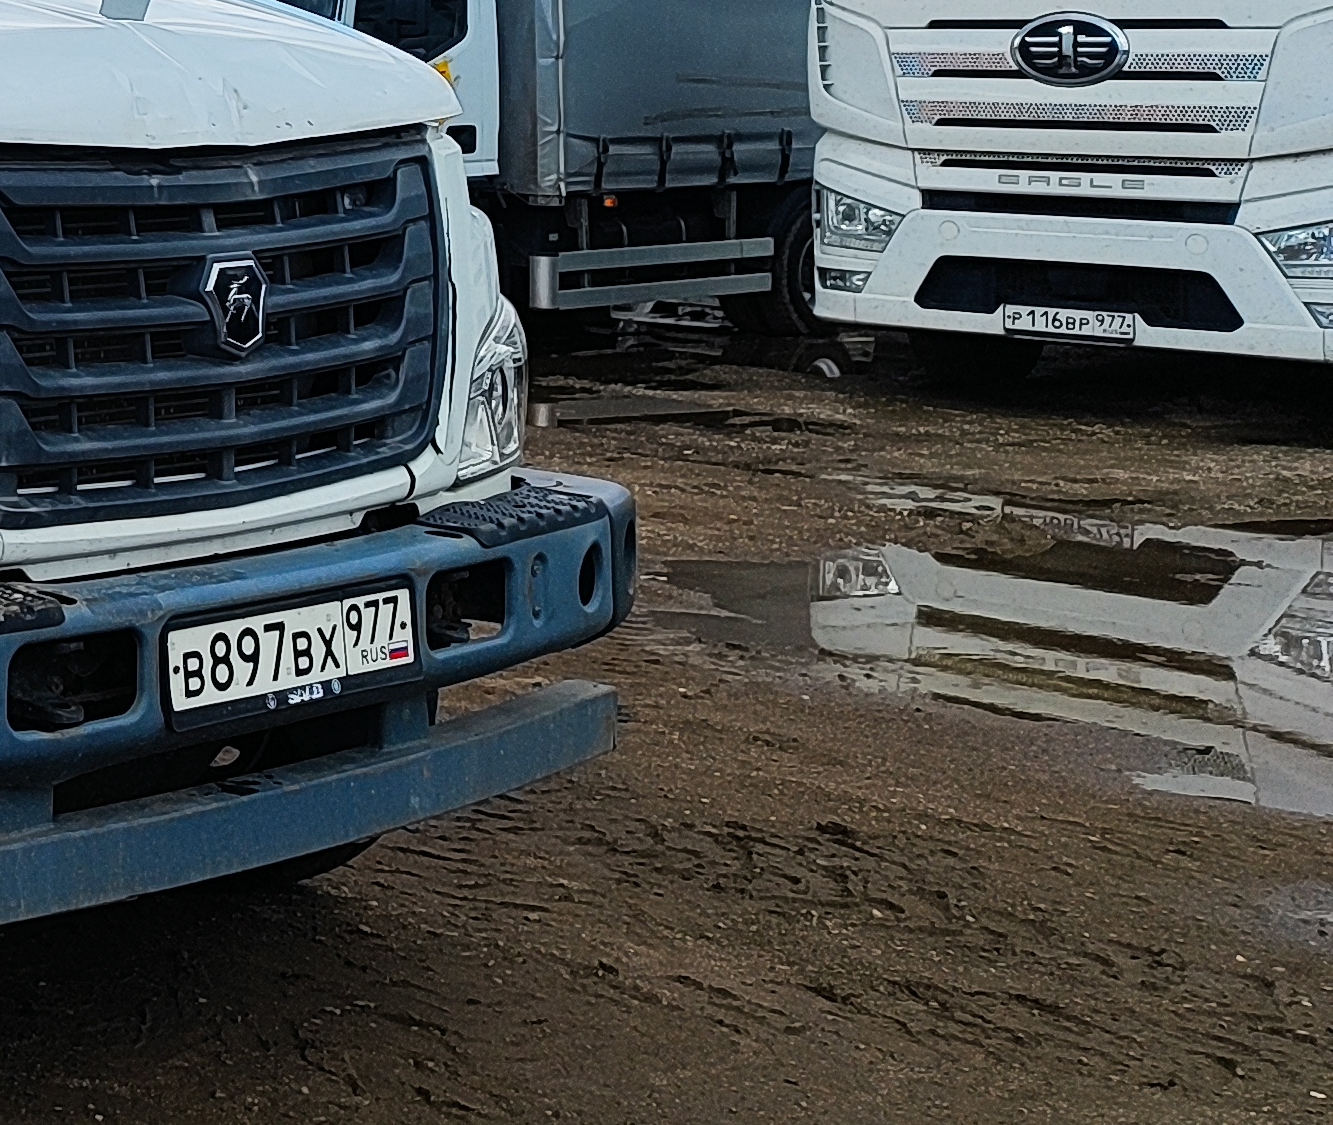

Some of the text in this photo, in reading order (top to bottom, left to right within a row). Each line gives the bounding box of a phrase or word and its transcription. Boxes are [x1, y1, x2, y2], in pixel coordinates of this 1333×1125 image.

[997, 173, 1146, 190] EAGLE
[345, 594, 399, 649] 977
[360, 645, 389, 666] RUS
